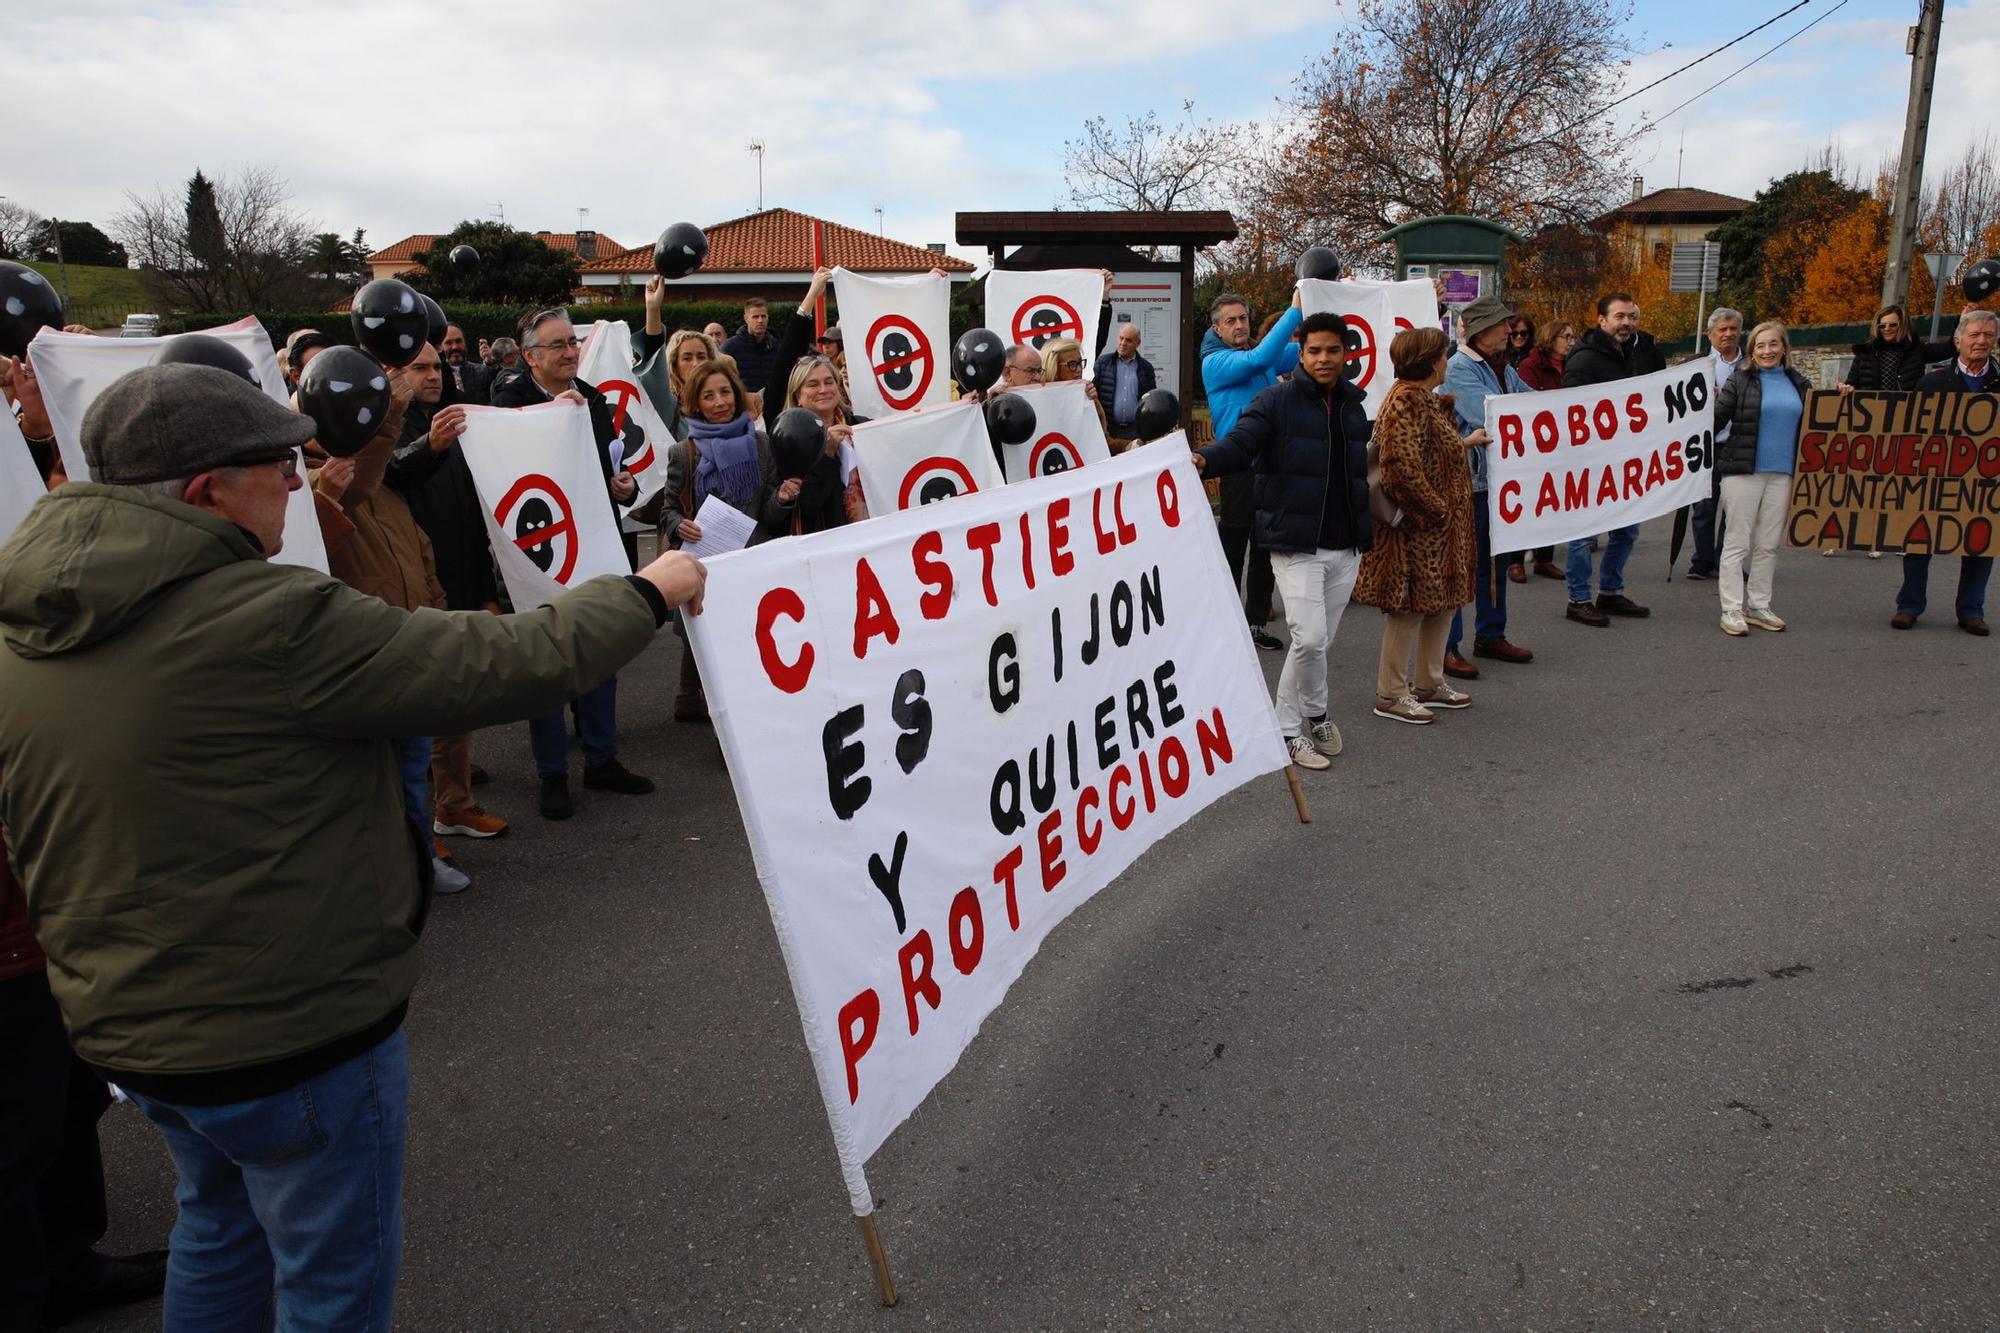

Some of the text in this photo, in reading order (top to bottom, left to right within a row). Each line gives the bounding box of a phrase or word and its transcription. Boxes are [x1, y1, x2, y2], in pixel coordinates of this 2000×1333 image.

[1498, 372, 1708, 459] ROBOS NO
[1798, 432, 2000, 478] SAQUEADO
[1808, 390, 1998, 436] CASTIELLO
[755, 469, 1180, 694] CASTIELLO
[1789, 508, 1993, 556] CALLADO
[821, 565, 1166, 821] ES GIJON
[868, 660, 1186, 934] Y QUIERE
[838, 708, 1233, 1105] PROTECCION
